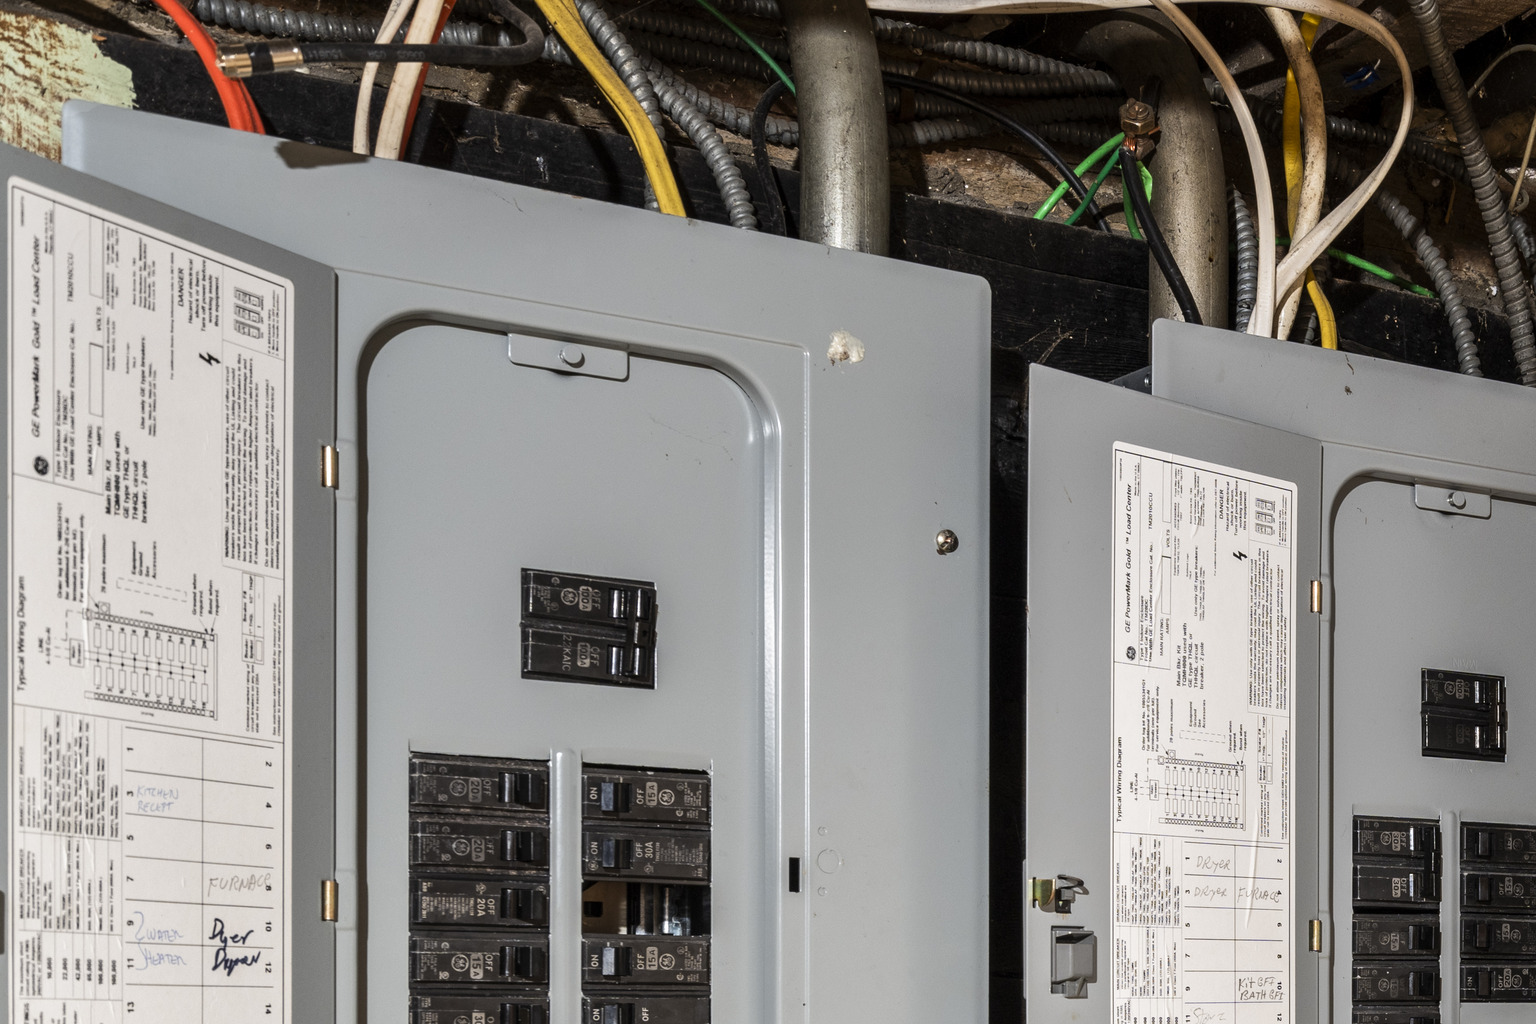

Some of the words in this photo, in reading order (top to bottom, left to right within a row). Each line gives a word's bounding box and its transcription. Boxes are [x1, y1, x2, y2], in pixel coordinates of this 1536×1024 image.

[32, 235, 40, 273] Center
[32, 275, 40, 304] Load
[32, 321, 40, 349] Gold
[32, 356, 40, 417] PowerMark
[32, 418, 40, 437] GE
[17, 576, 26, 618] Diagram
[592, 590, 601, 609] OFF
[1124, 619, 1132, 633] GE
[17, 621, 26, 653] Wiring
[591, 646, 600, 666] OFF
[17, 656, 26, 691] Typical
[471, 780, 480, 802] 20A
[590, 786, 598, 800] ON
[636, 788, 644, 804] OFF
[648, 782, 656, 805] 15A
[474, 840, 484, 860] 20A
[590, 841, 598, 854] ON
[644, 841, 654, 858] 30A
[478, 898, 486, 917] 20A
[487, 898, 495, 916] OFF
[472, 956, 482, 978] 15A
[484, 954, 493, 972] OFF
[591, 954, 598, 968] ON
[637, 954, 645, 970] OFF
[648, 948, 657, 970] 15A
[593, 1008, 600, 1022] ON
